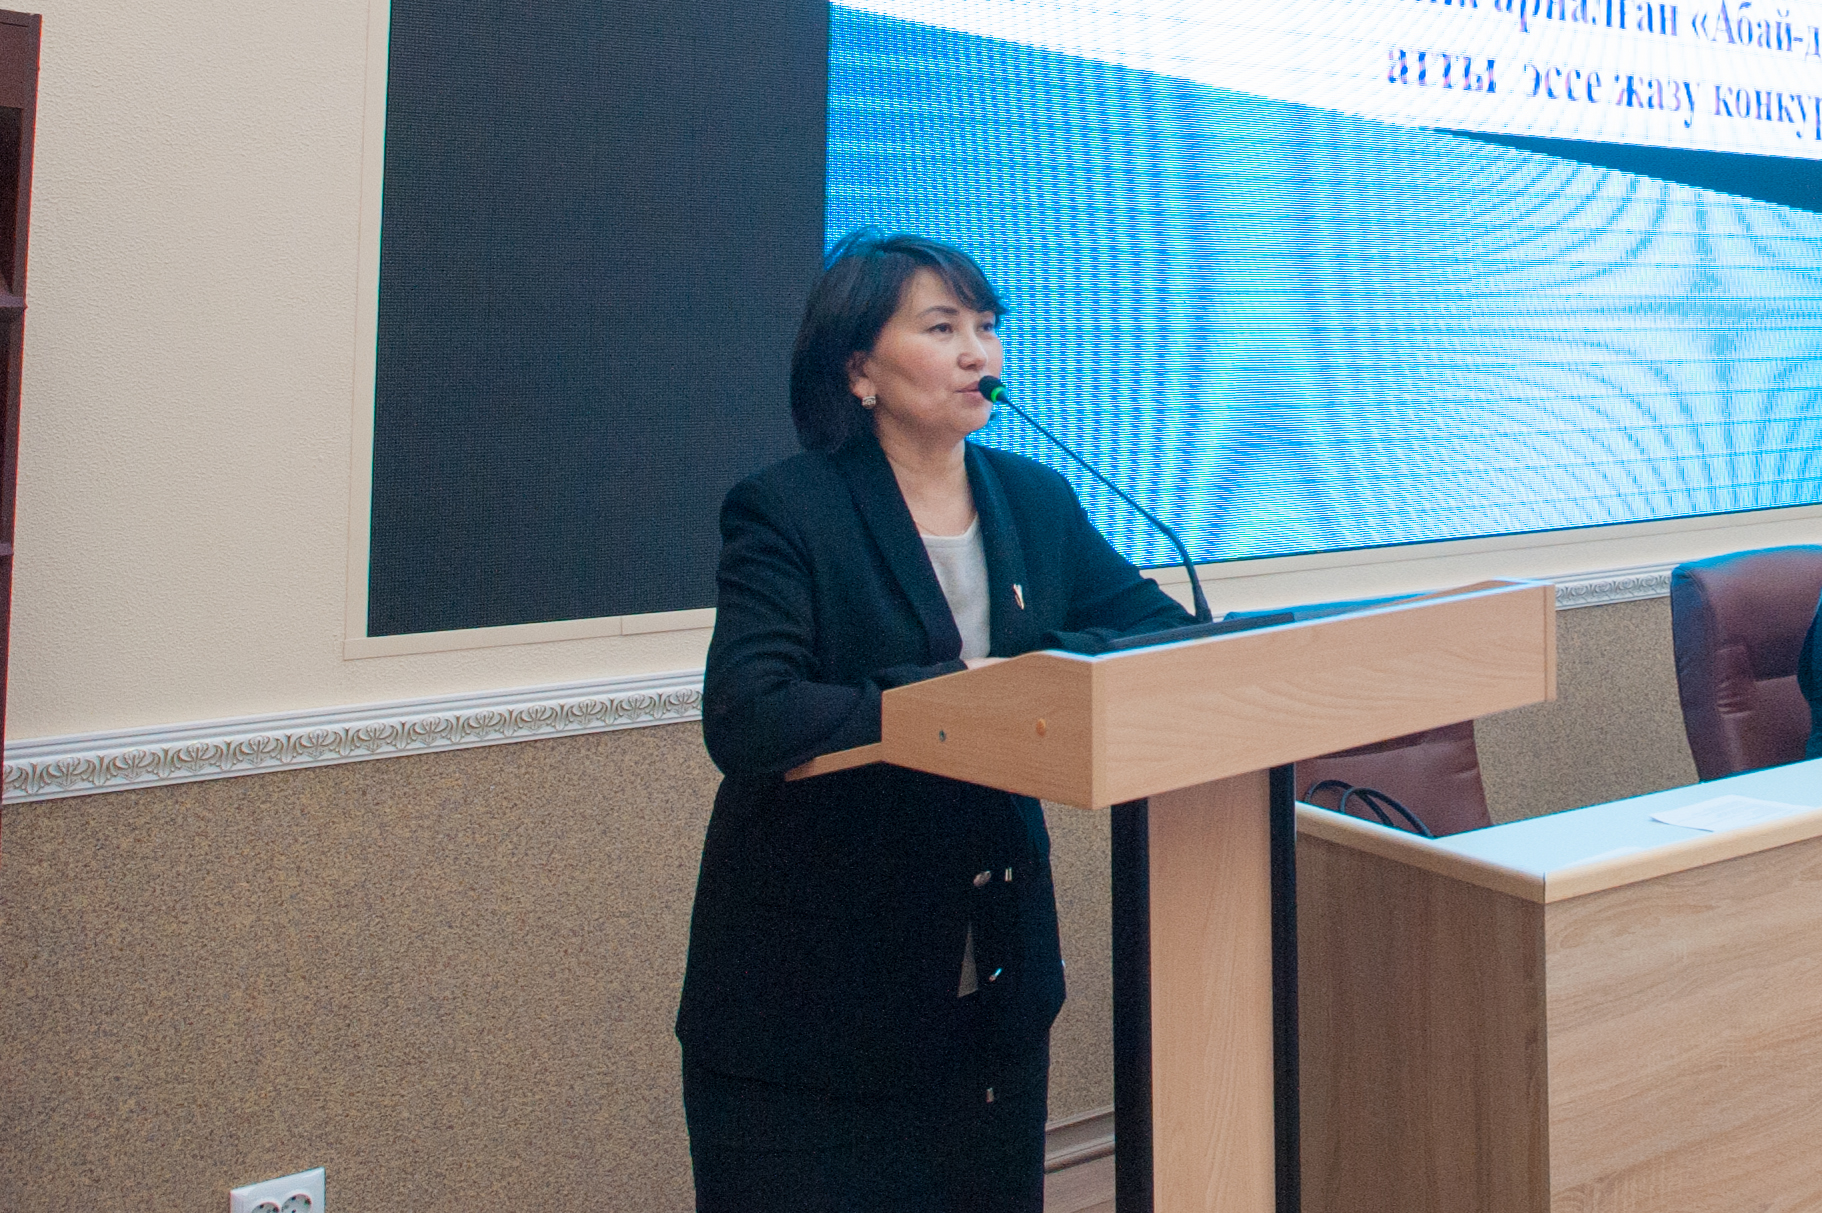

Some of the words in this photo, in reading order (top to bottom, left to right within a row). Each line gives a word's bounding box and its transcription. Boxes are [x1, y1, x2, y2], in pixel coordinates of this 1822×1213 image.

[1387, 48, 1496, 93] атты
[1523, 62, 1601, 103] эссе
[1615, 70, 1700, 127] жазу
